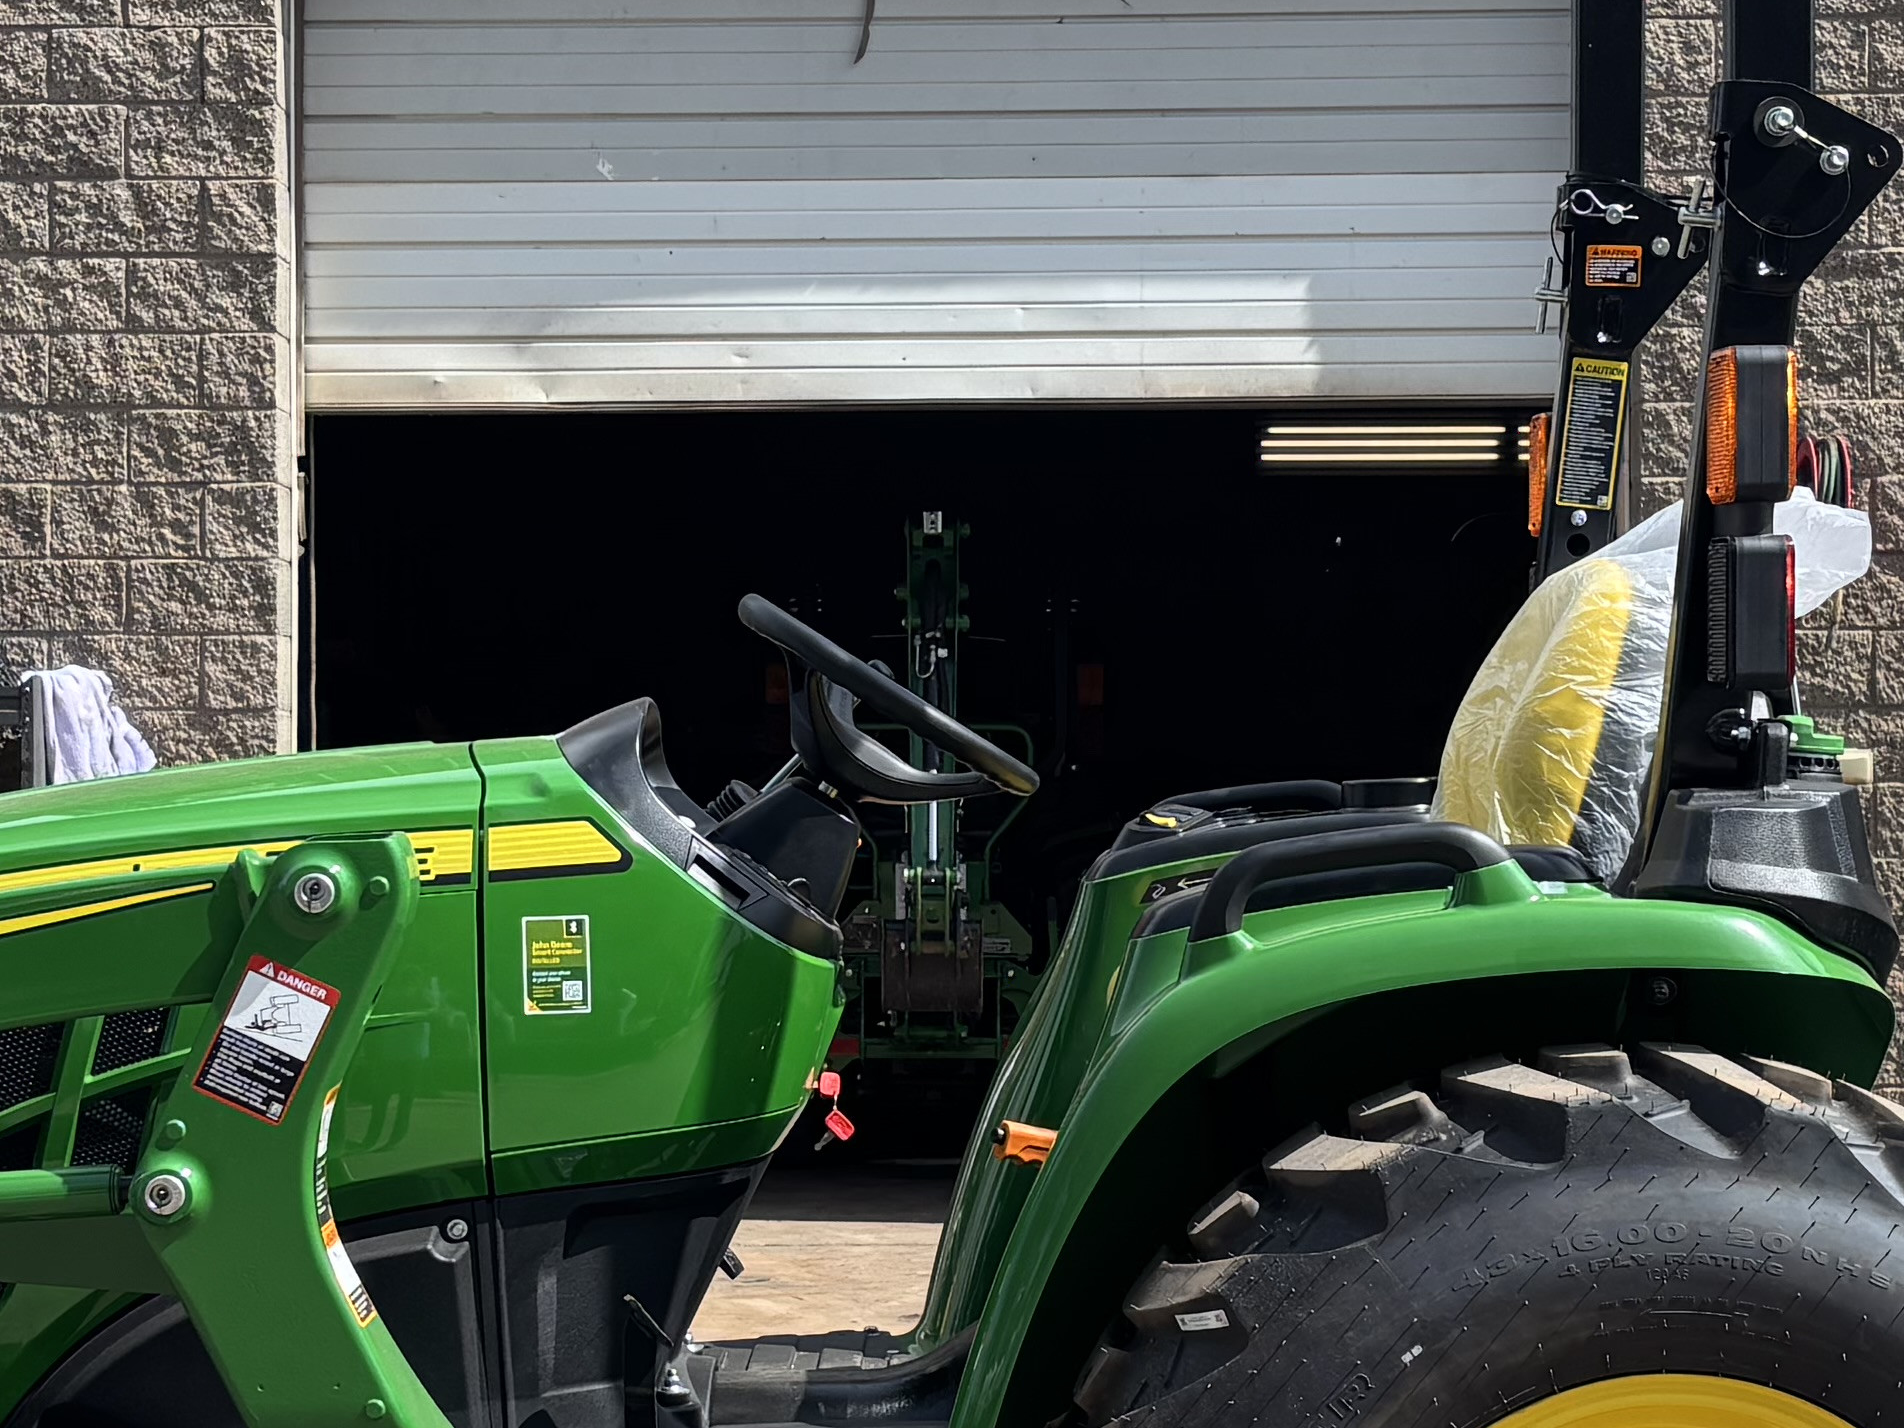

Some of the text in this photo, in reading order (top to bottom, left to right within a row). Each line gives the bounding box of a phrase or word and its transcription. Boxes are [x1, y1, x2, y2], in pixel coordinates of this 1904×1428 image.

[1585, 364, 1625, 377] CAUTION
[276, 970, 328, 1000] DANGER
[1586, 1251, 1657, 1276] PLY
[1663, 1252, 1786, 1278] RATING
